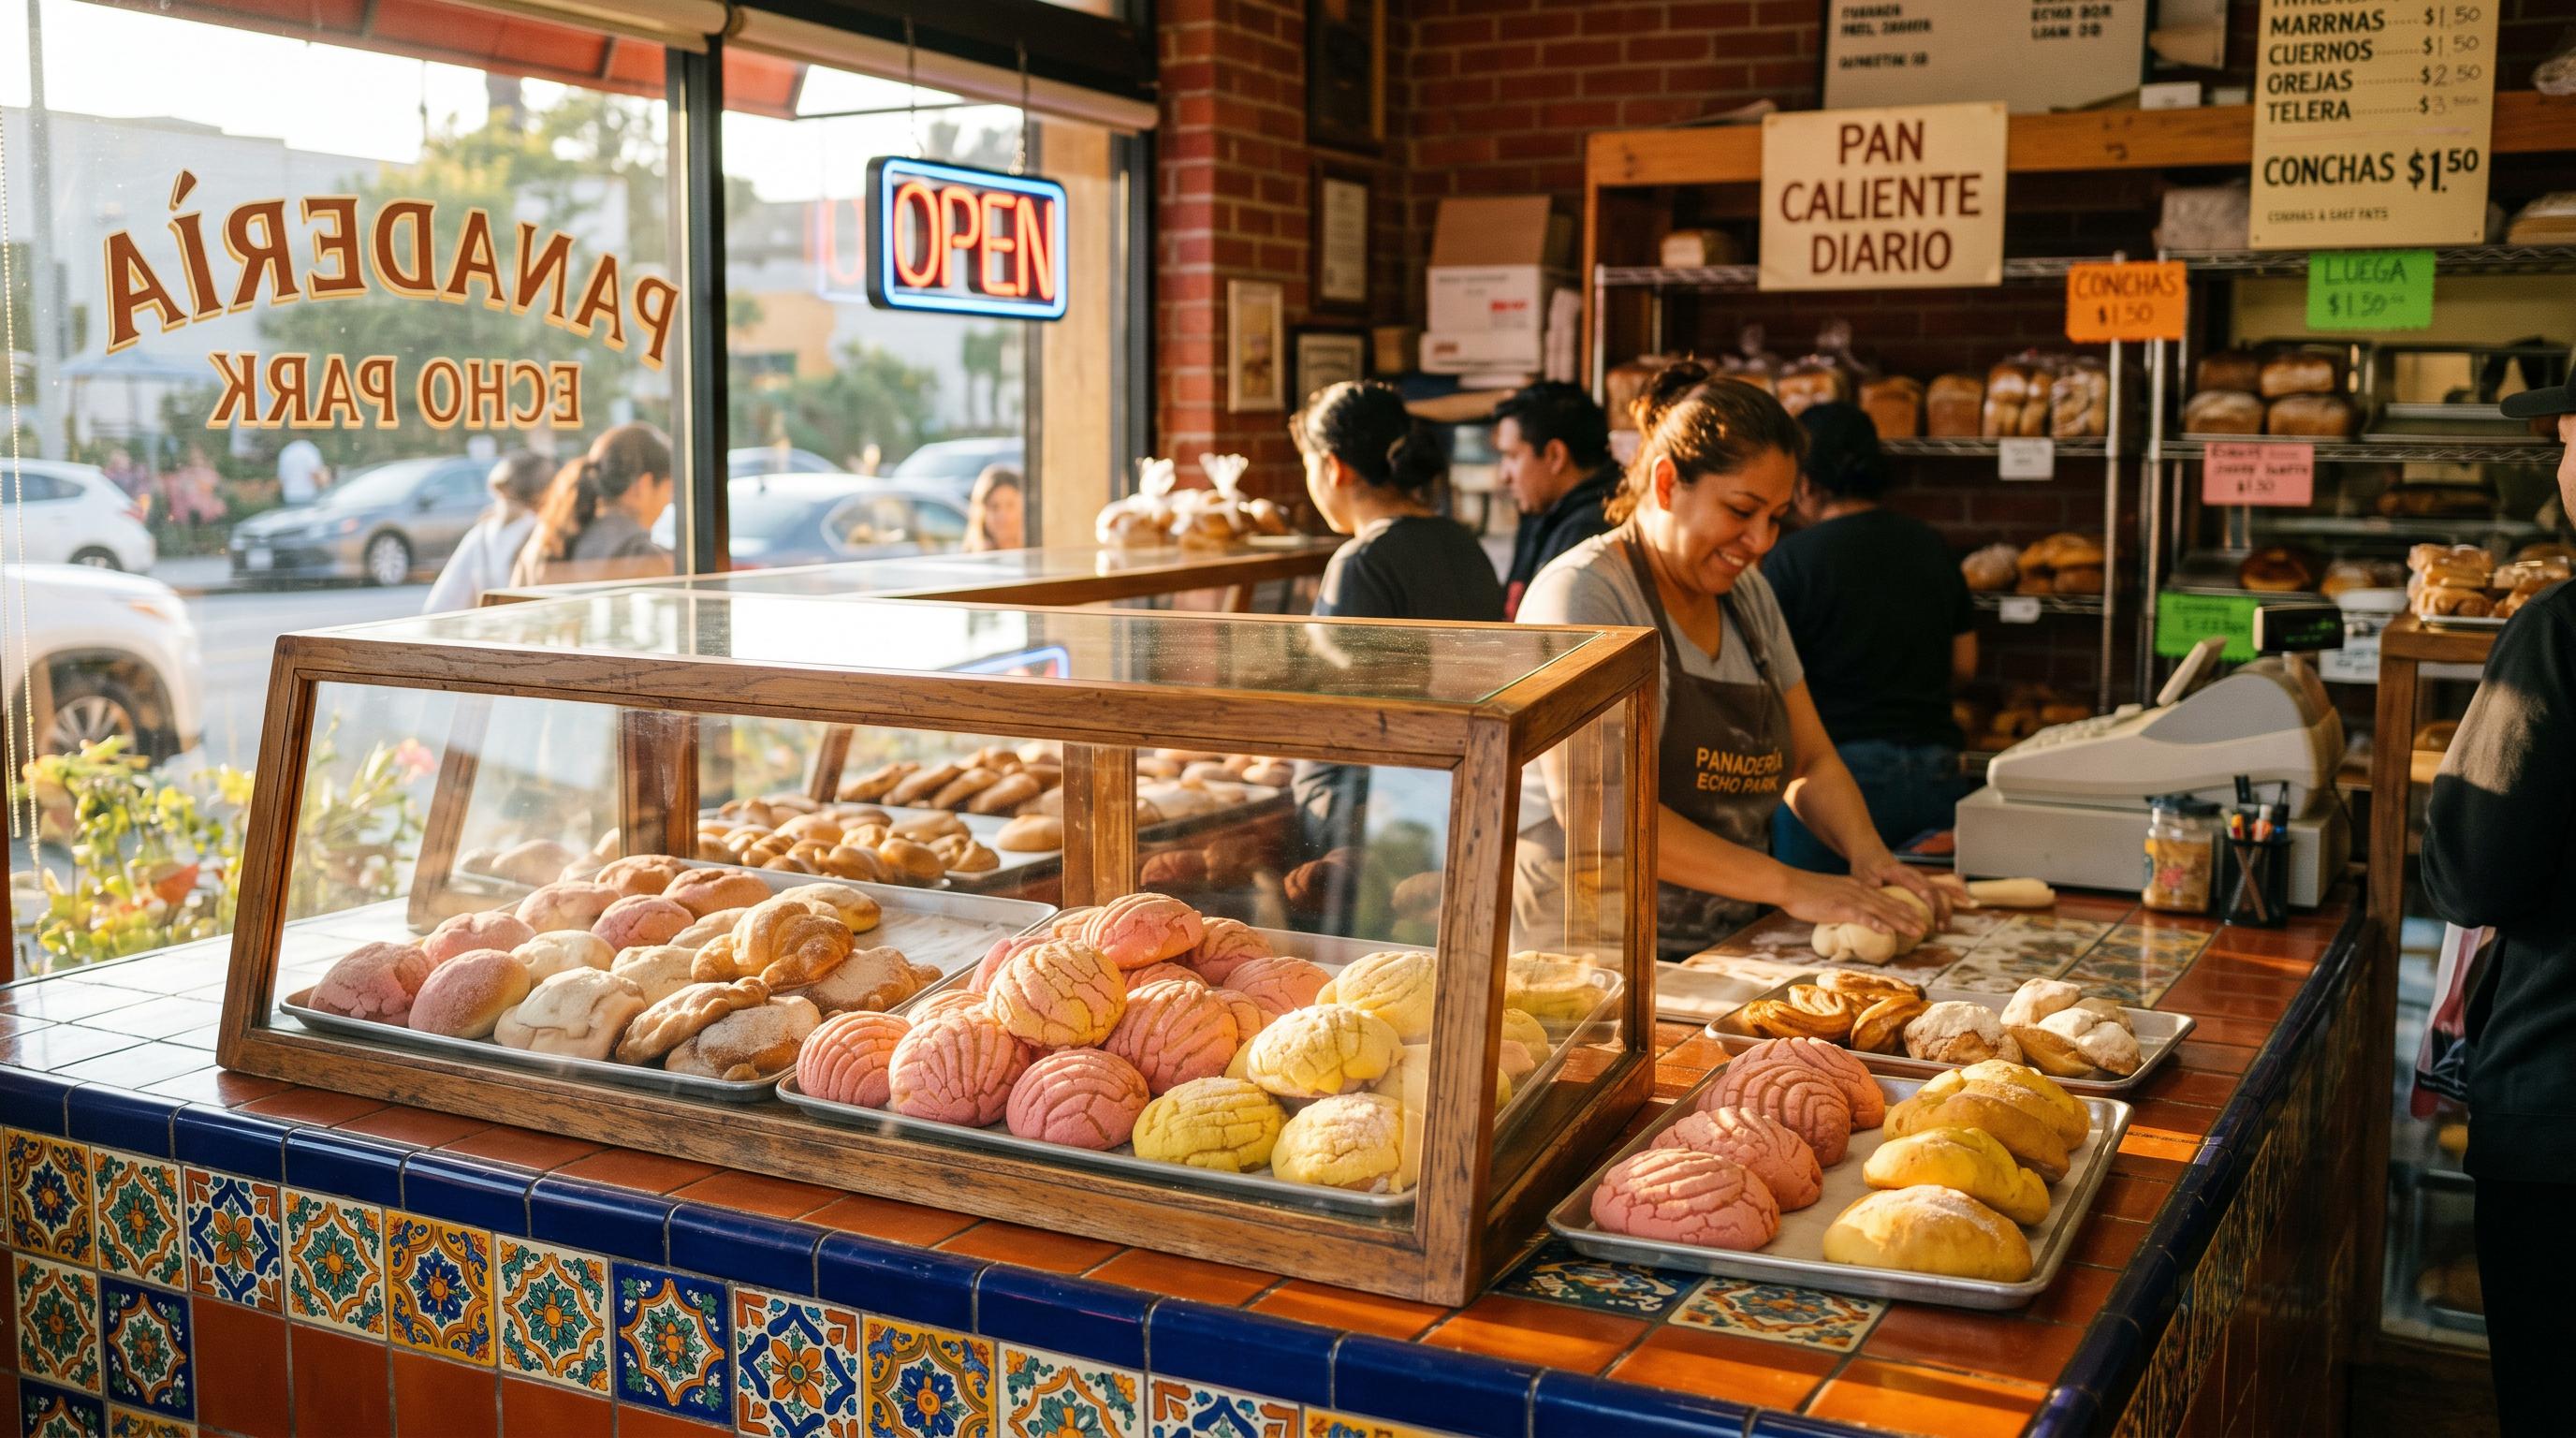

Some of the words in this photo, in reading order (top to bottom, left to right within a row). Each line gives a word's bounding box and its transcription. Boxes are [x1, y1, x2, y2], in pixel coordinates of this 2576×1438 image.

[2270, 7, 2385, 36] MARRNAS
[2424, 6, 2481, 28] $1.50
[2268, 38, 2373, 66] CUERNOS
[2422, 35, 2480, 57] $1.50
[2266, 69, 2353, 95] OREJAS
[2266, 100, 2351, 124] TELERA
[1839, 119, 1925, 165] PAN
[2263, 152, 2395, 187] CONCHAS
[2407, 147, 2480, 193] $1.50
[1781, 172, 1982, 223] CALIENTE
[894, 181, 1055, 301] OPEN
[1811, 229, 1953, 274] DIARIO
[2074, 270, 2180, 300] CONCHAS
[2324, 256, 2408, 286] LUEGA
[1696, 771, 1740, 793] ECHO
[1741, 775, 1778, 793] PARK
